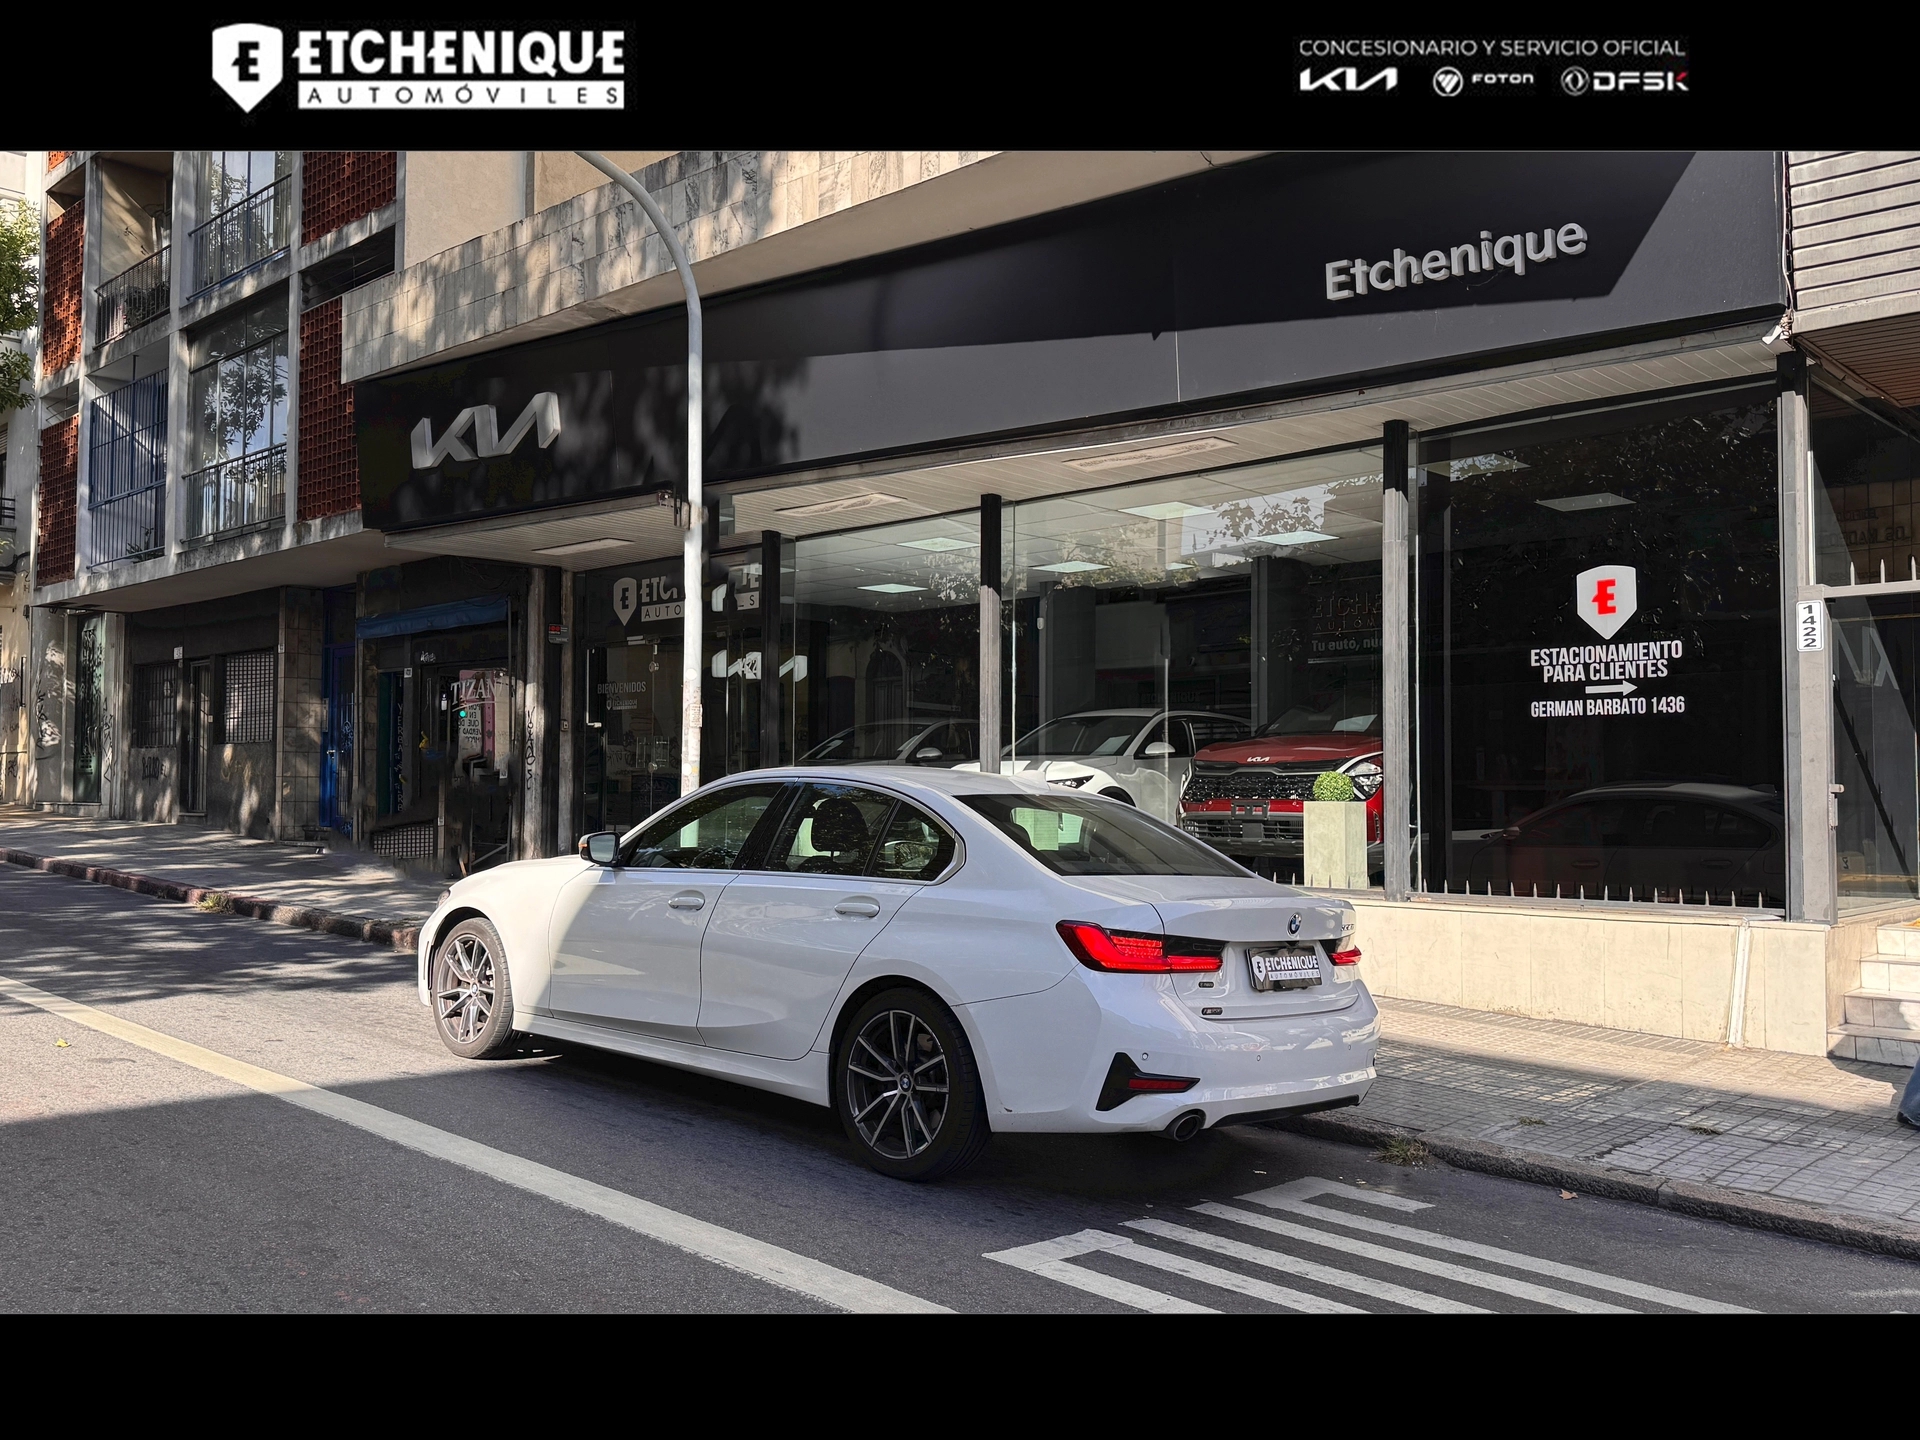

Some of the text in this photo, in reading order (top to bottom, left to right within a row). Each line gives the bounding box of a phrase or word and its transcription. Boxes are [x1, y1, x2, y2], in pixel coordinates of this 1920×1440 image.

[1325, 222, 1588, 301] Etchenique
[410, 391, 561, 470] KIA
[1802, 604, 1817, 648] 1422
[1531, 640, 1682, 666] ESTACIONAMIENTO
[1543, 659, 1668, 683] PARA CLIENTES
[597, 681, 647, 695] BIENVENIDOS
[1531, 696, 1685, 717] GERMAN BARBATO 1436
[1265, 955, 1319, 971] ETCHENIQUE
